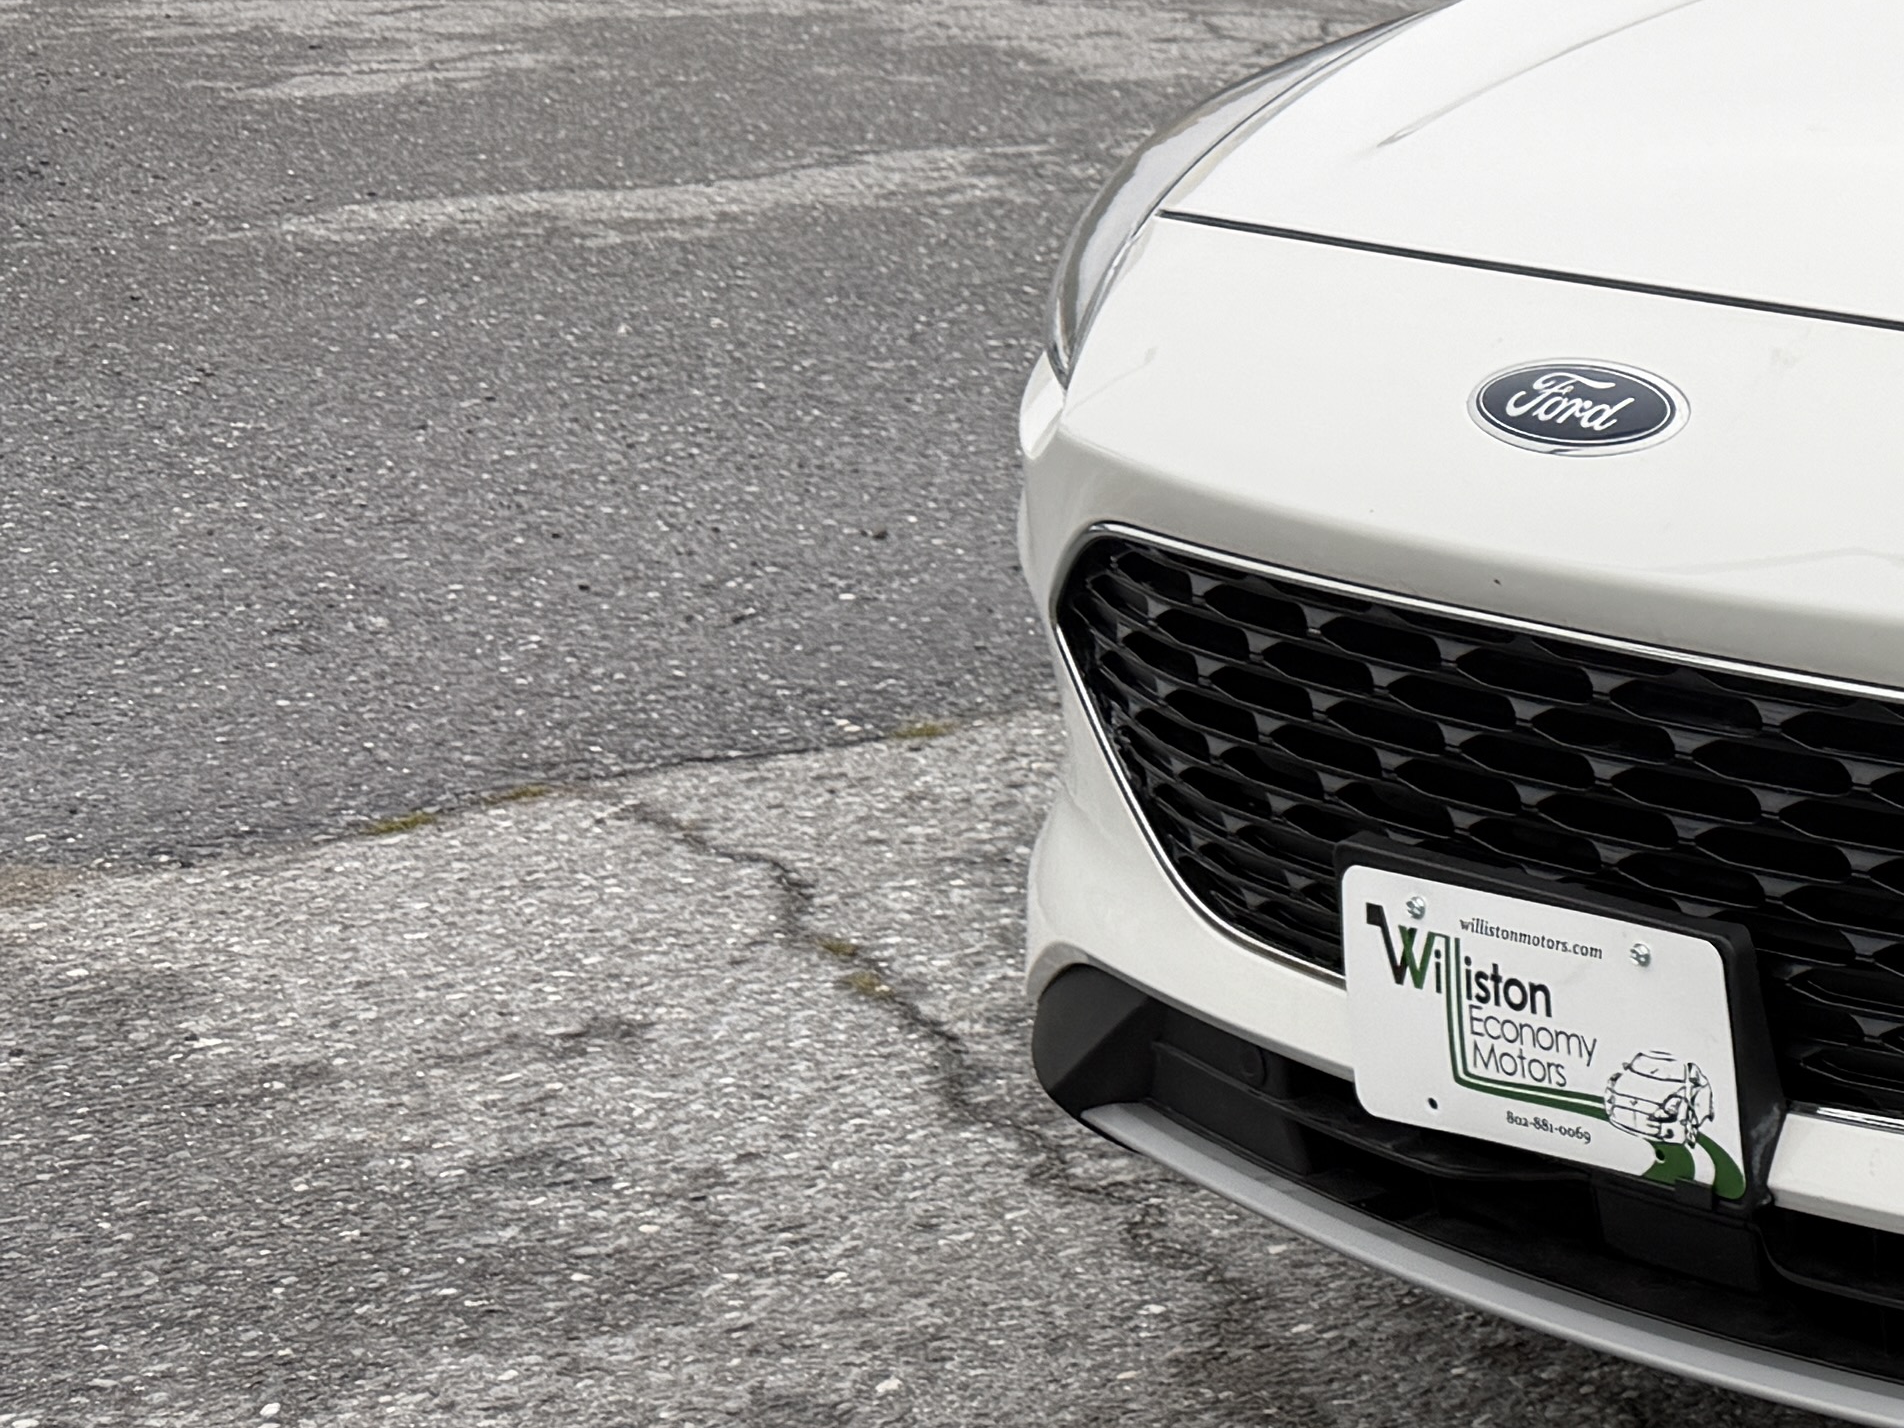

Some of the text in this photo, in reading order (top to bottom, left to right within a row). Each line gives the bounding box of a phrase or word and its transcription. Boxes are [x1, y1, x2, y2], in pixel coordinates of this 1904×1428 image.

[1506, 372, 1635, 432] Ford
[1365, 901, 1553, 1019] Williston
[1459, 917, 1603, 960] willistonmotors.com
[1468, 1004, 1598, 1068] Economy
[1472, 1039, 1568, 1088] Motors
[1506, 1110, 1592, 1145] 802-881-0069
